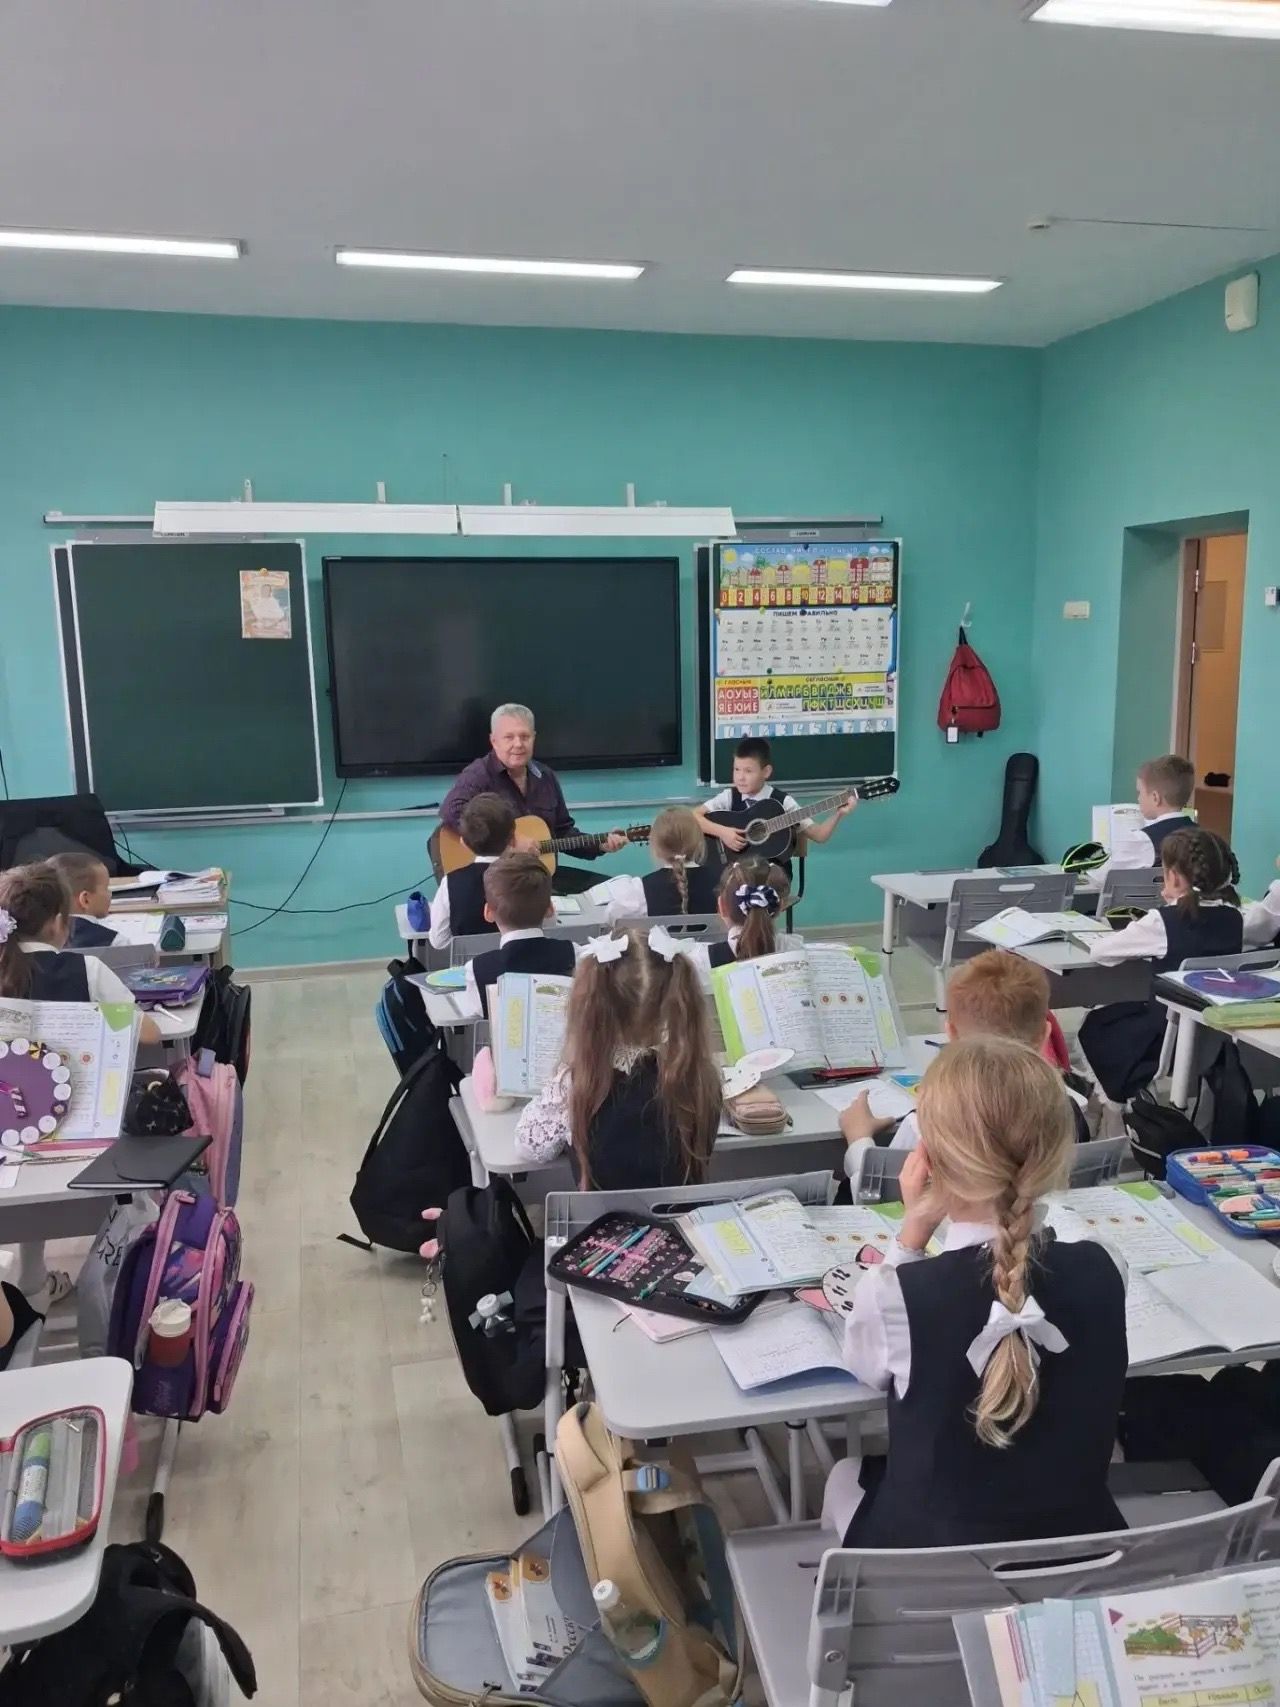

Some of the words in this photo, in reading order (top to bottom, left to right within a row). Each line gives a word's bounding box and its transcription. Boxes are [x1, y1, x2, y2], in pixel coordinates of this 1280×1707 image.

[737, 591, 744, 602] 2
[754, 590, 760, 602] 4
[818, 590, 826, 600] 12
[835, 590, 842, 600] 14
[852, 589, 859, 600] 16
[773, 610, 798, 618] ПИШЕМ
[832, 1269, 851, 1281] 12
[832, 1285, 849, 1297] 11
[841, 1300, 854, 1312] 10
